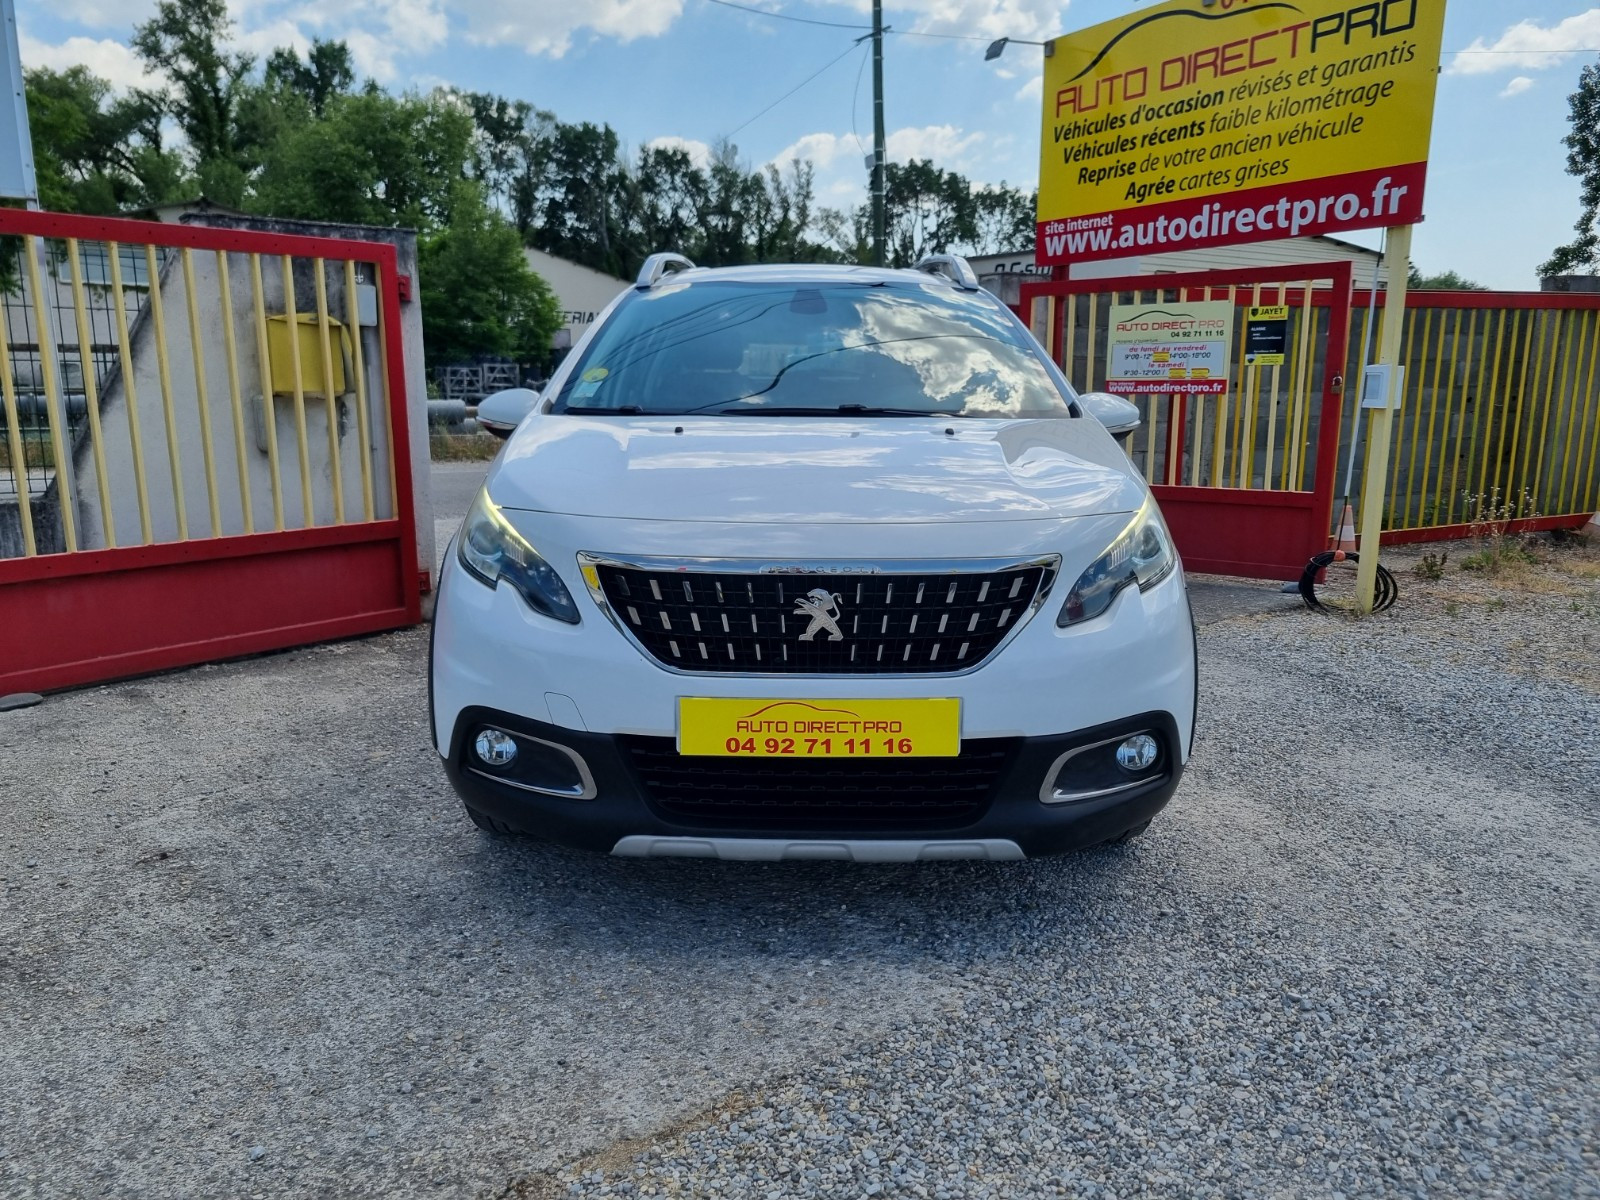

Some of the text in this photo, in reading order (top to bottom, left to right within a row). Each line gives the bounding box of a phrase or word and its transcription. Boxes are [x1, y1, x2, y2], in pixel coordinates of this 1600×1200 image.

[1054, 40, 1416, 143] Véhicules d'occasion révisés et garantis
[1056, 67, 1148, 118] AUTO
[1063, 80, 1394, 164] Véhicules récents faible kilométrage
[1078, 112, 1364, 186] Reprise de votre ancien véhicule
[1124, 158, 1290, 203] Agrée cartes grises
[1044, 177, 1408, 257] www.autodirectpro.fr
[1045, 214, 1114, 235] site internet
[1117, 320, 1225, 332] AUTO DIRECT PRO
[1109, 382, 1223, 393] www.autodirectpro.fr
[726, 738, 913, 753] 04 92 71 11 16
[737, 721, 788, 733] AUTO
